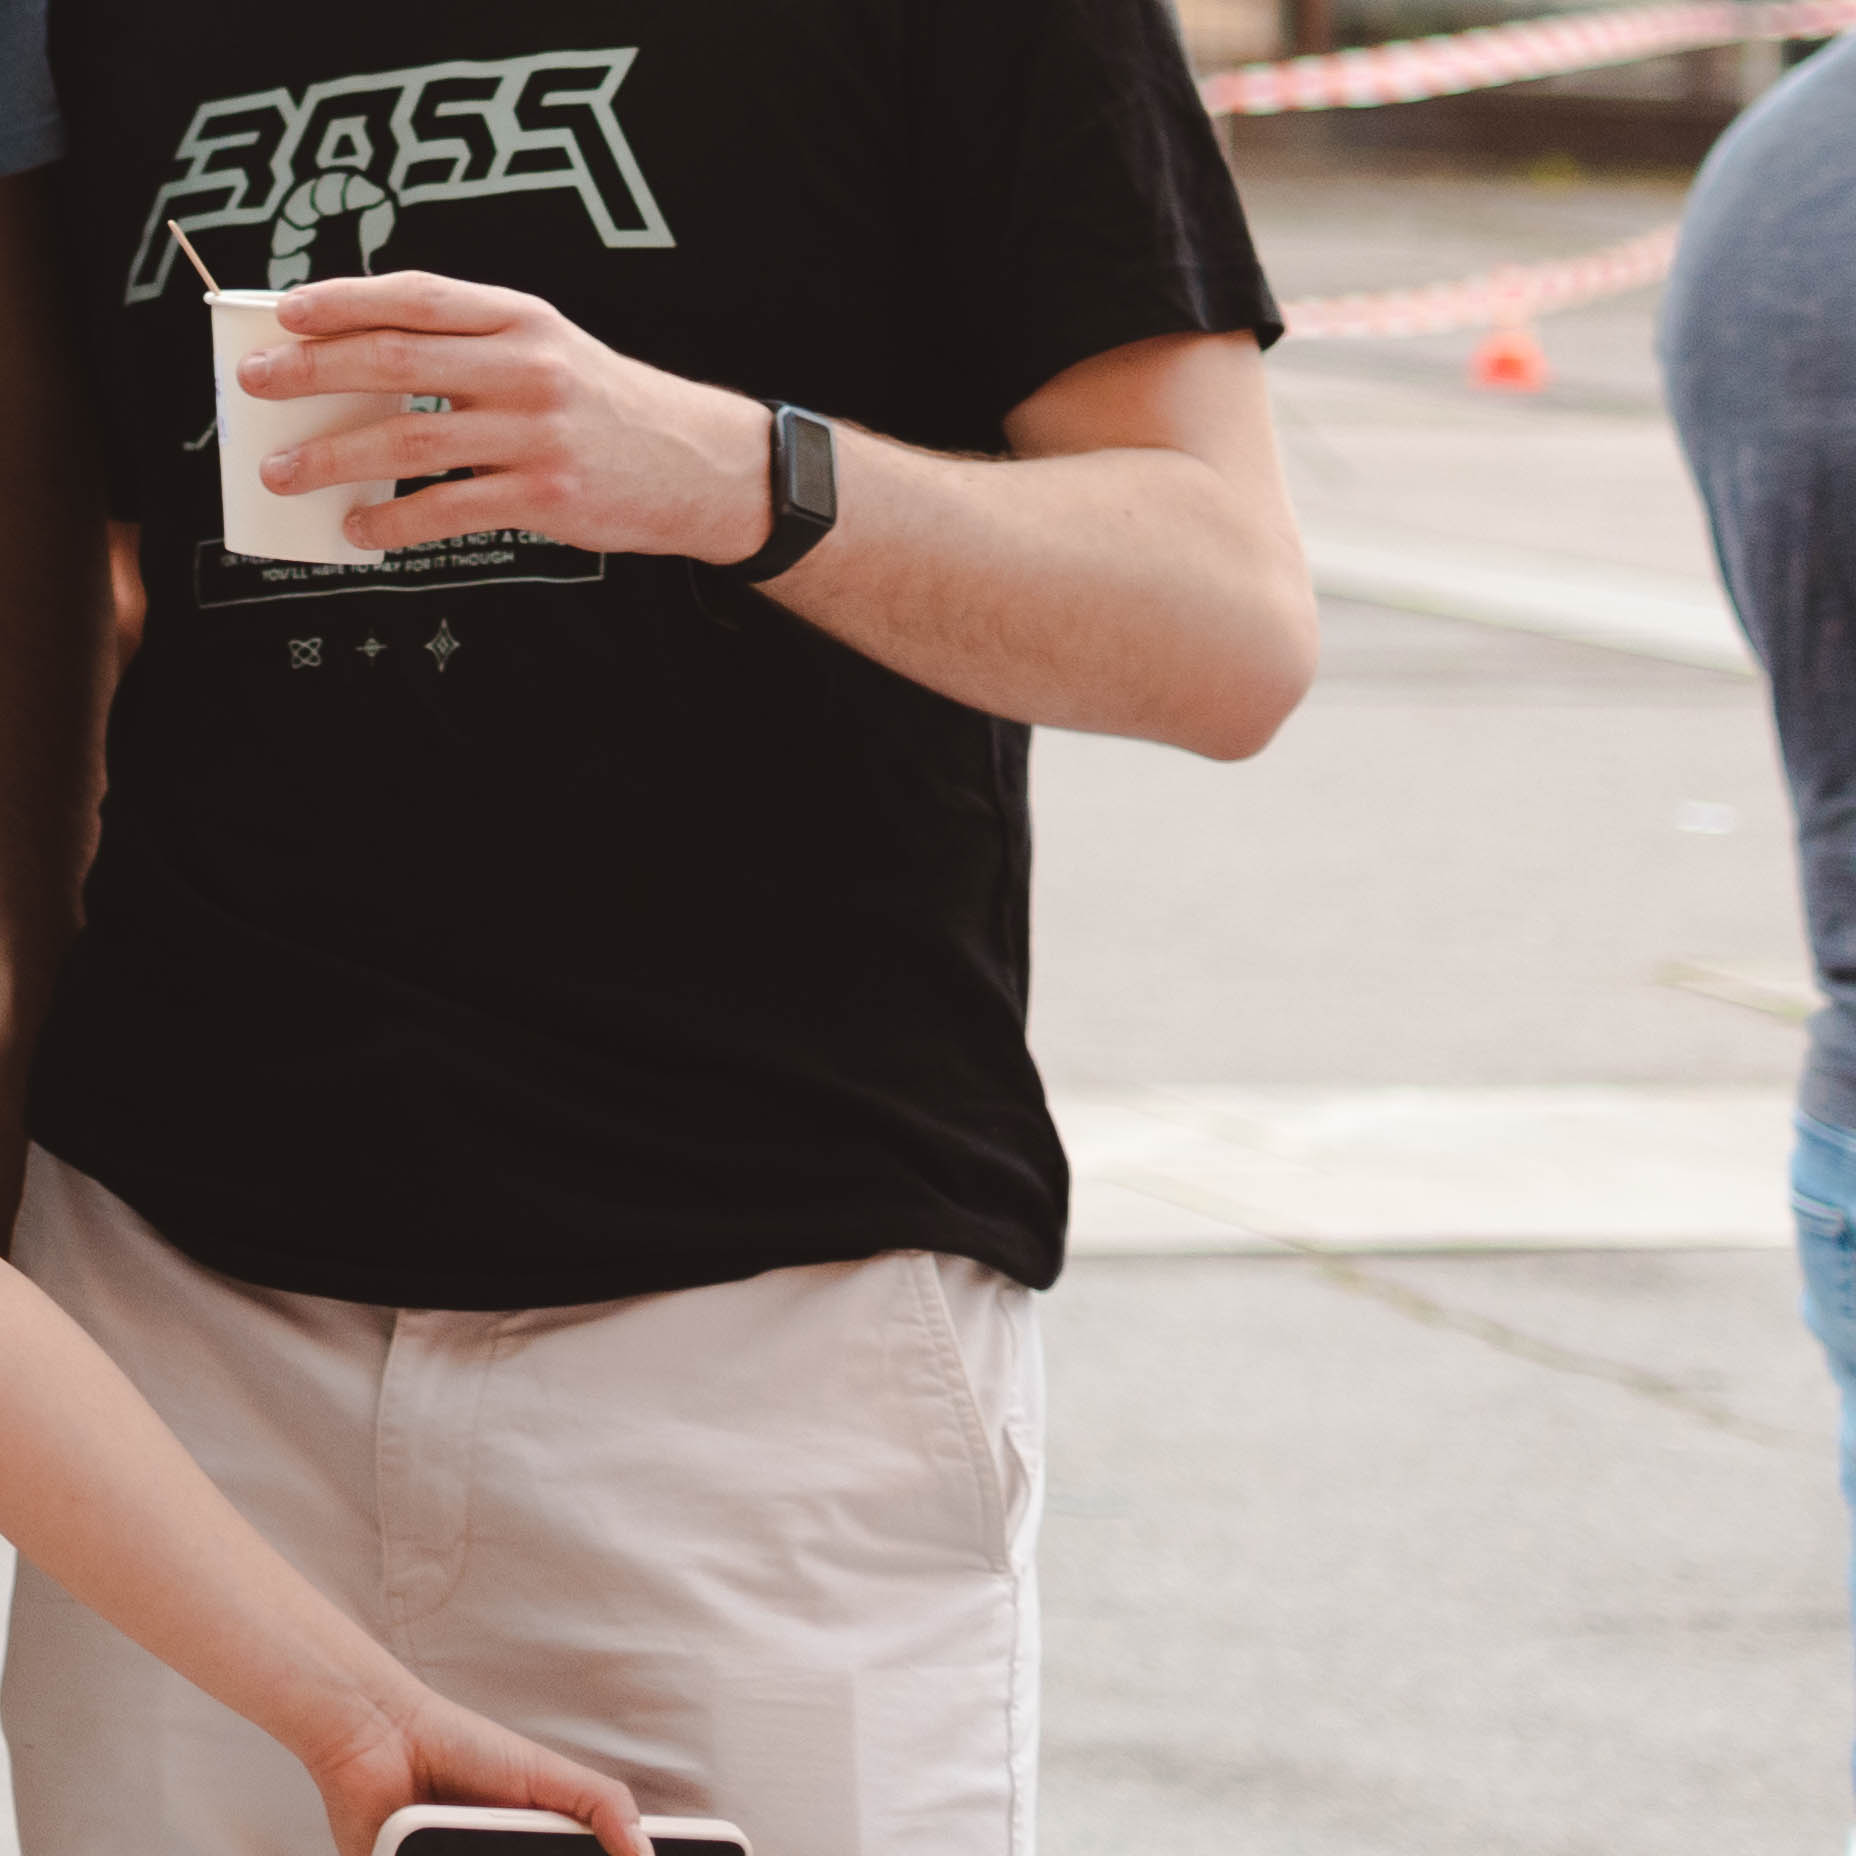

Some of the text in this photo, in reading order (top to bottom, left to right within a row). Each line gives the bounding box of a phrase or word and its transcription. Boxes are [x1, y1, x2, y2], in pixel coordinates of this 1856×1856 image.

[501, 530, 514, 544] A
[404, 558, 431, 572] FOR
[433, 555, 447, 568] IT
[451, 550, 515, 568] THOUGH
